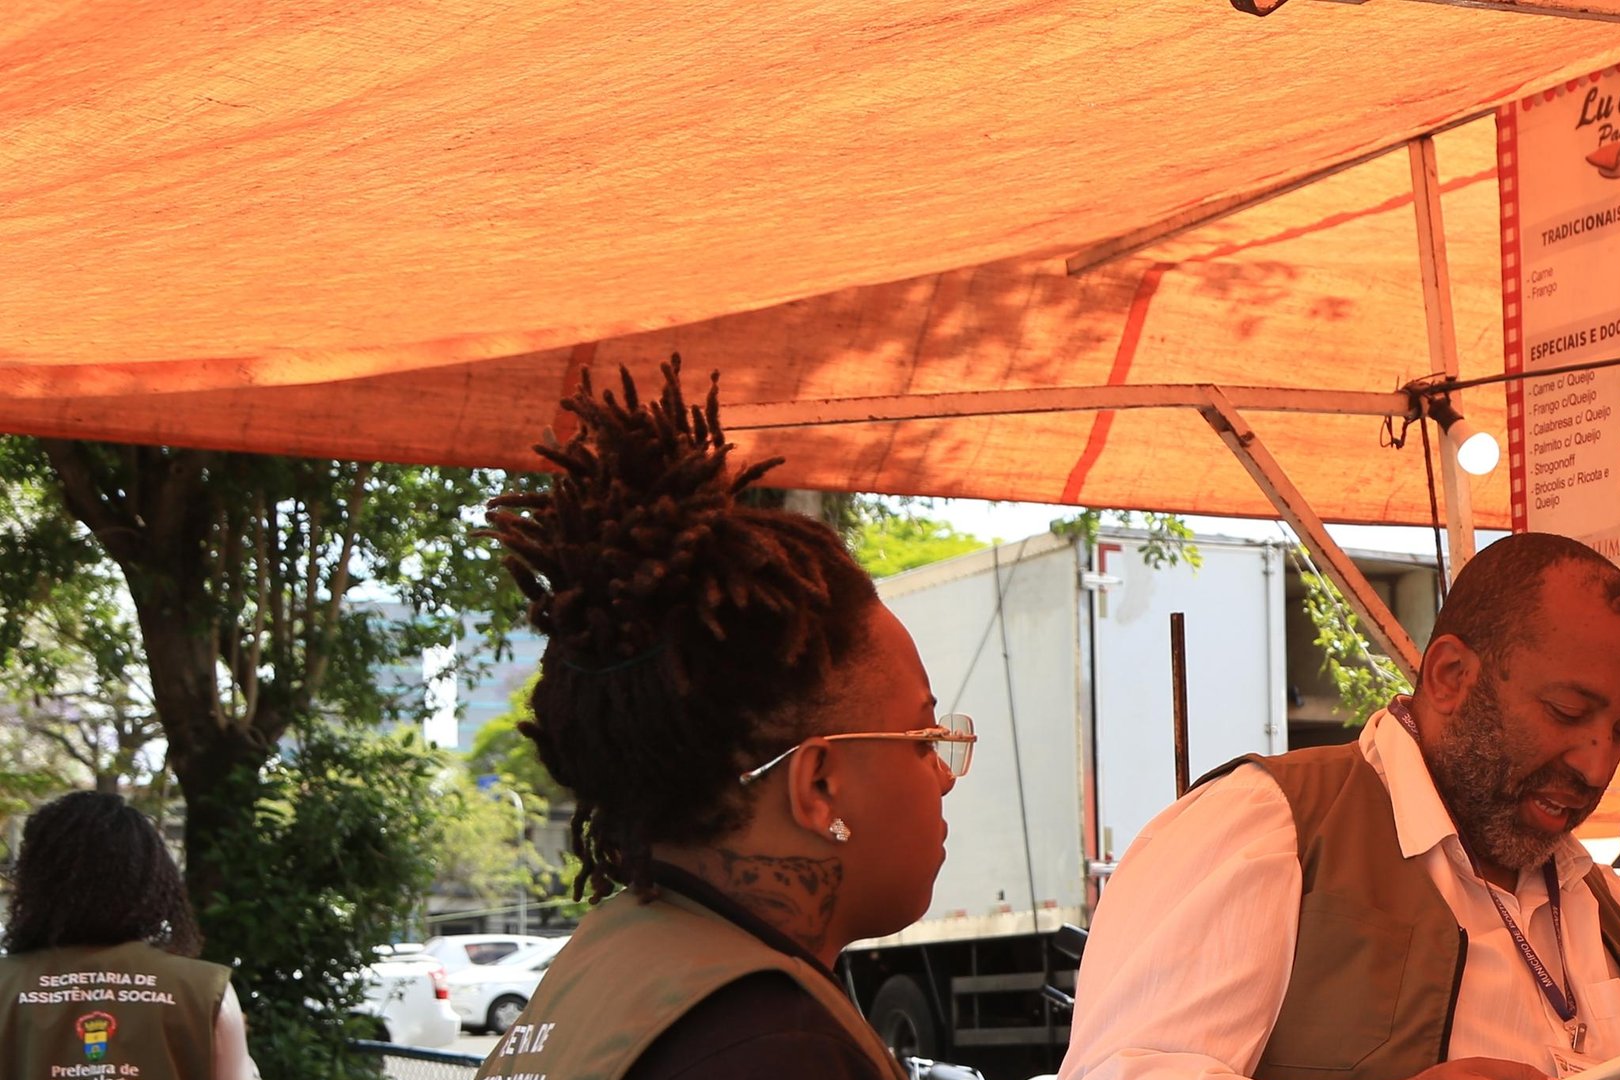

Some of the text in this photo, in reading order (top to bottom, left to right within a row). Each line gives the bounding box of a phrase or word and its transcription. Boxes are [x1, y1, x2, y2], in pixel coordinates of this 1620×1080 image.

[1576, 86, 1614, 131] Lu
[1530, 330, 1588, 362] ESPECIAIS
[1590, 328, 1597, 342] E
[1533, 400, 1561, 417] Frango
[1533, 418, 1573, 437] Calabresa
[1584, 405, 1612, 423] Queijo
[1533, 439, 1563, 456] Palmito
[1573, 429, 1602, 447] Queijo
[1534, 453, 1576, 476] Strogonoff
[1577, 469, 1603, 485] Ricota
[39, 971, 157, 987] SECRETARIA DE
[18, 986, 177, 1005] ASSISTÊNCIA SOCIAL
[119, 1063, 140, 1077] de
